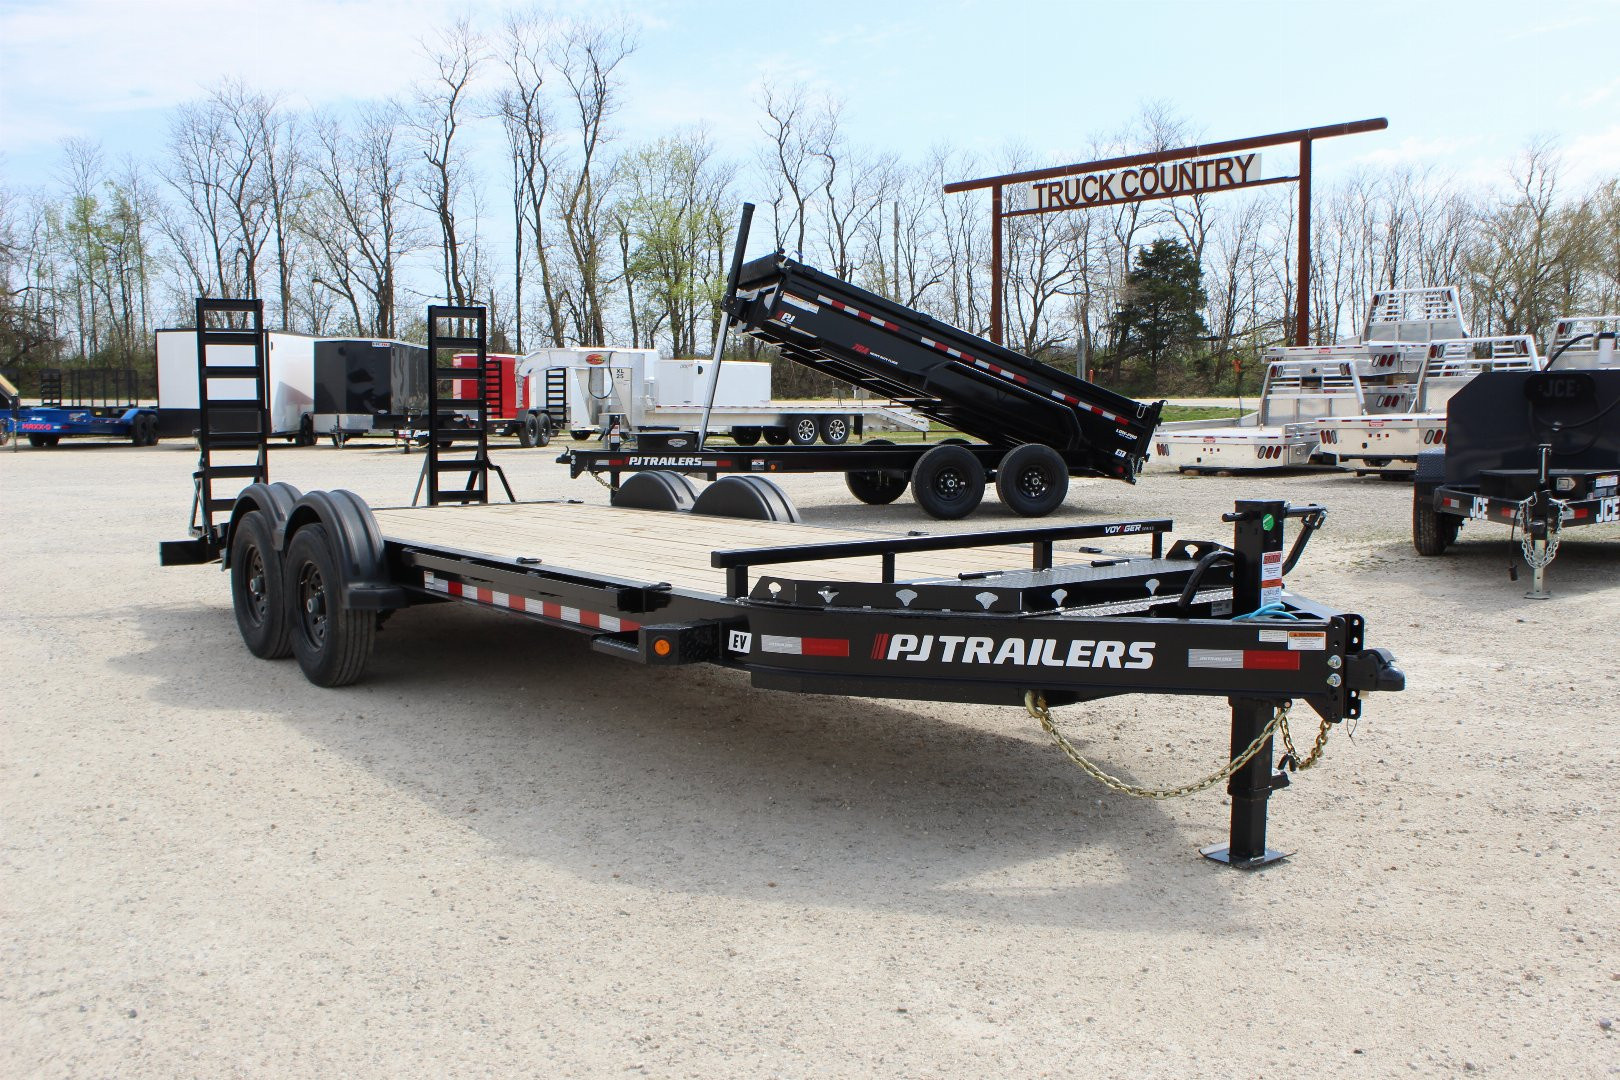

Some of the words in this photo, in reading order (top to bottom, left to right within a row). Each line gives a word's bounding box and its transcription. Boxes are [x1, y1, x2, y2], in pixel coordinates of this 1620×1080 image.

[1033, 174, 1116, 209] TRUCK
[1120, 154, 1257, 198] COUNTRY
[780, 312, 796, 324] PJ
[1543, 379, 1576, 397] JCE
[629, 456, 644, 466] PJ
[643, 457, 703, 466] TRAILERS
[1469, 496, 1489, 520] JCE
[1596, 496, 1620, 523] JCE
[1105, 524, 1142, 534] VOYAGER
[732, 633, 748, 649] EV
[887, 633, 934, 661] PJ
[937, 634, 1156, 670] TRAILERS
